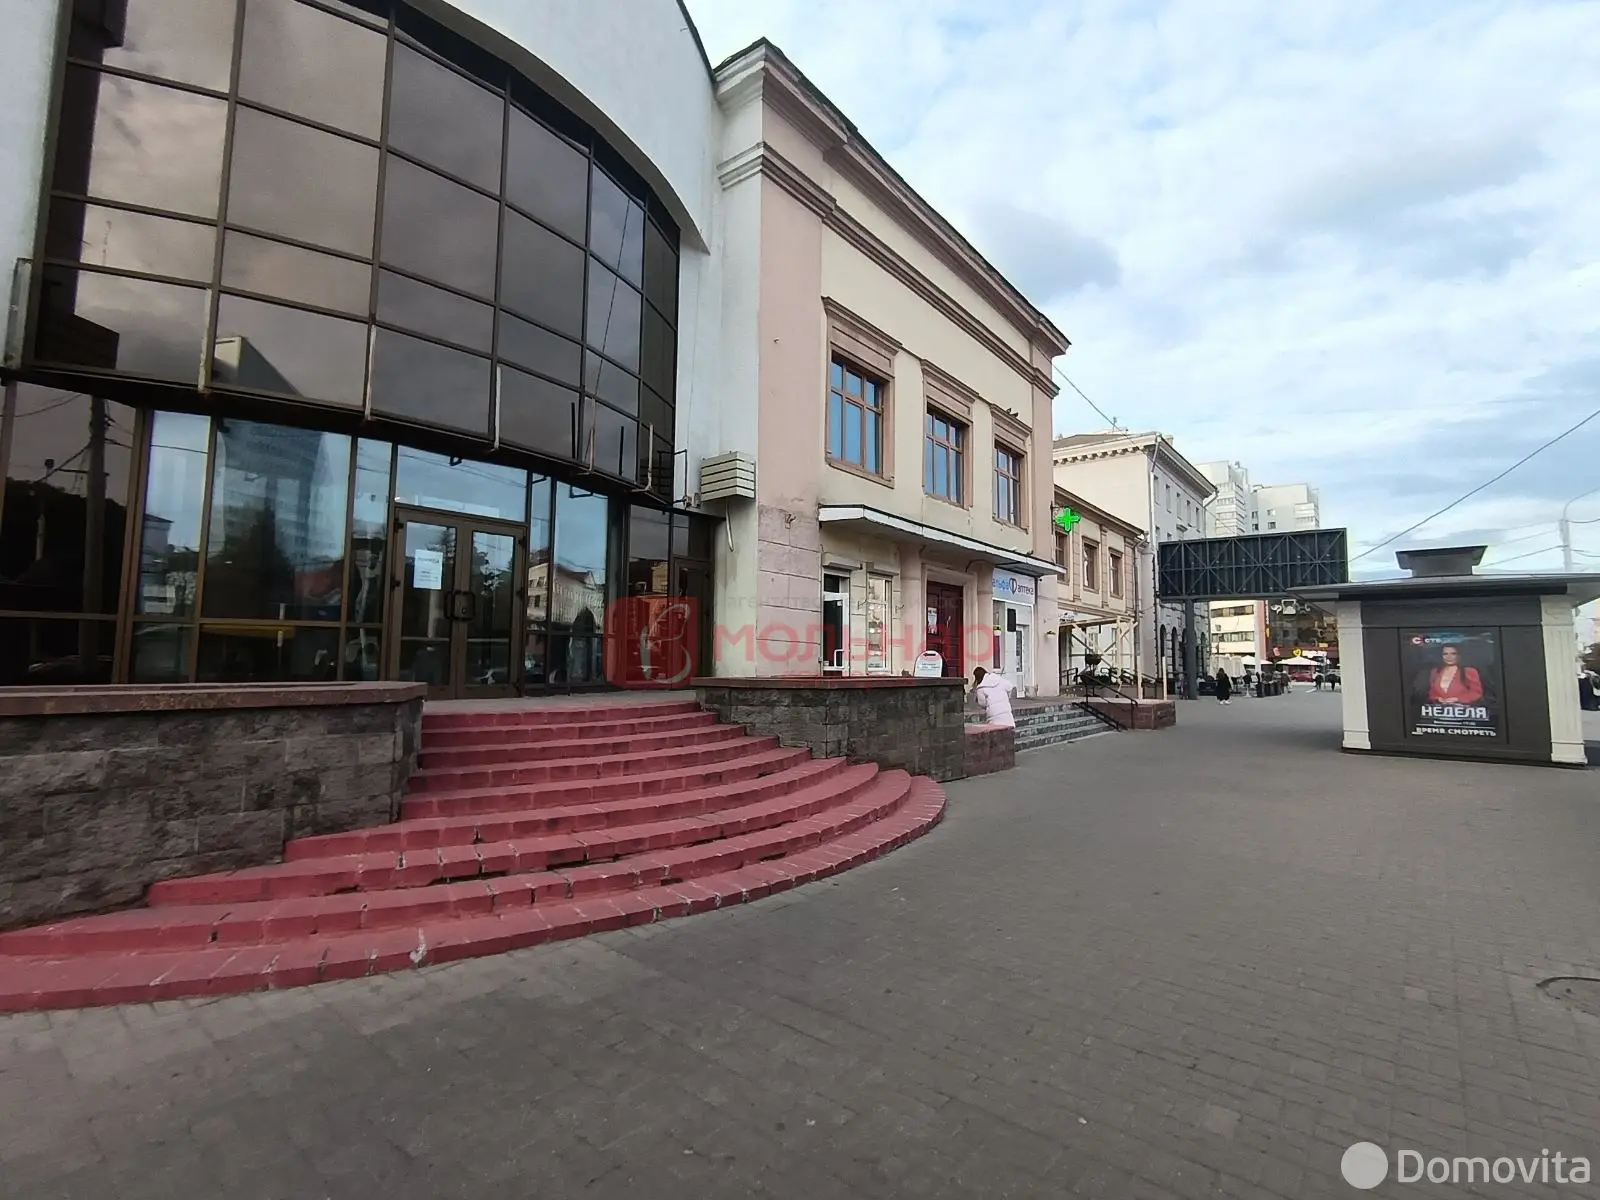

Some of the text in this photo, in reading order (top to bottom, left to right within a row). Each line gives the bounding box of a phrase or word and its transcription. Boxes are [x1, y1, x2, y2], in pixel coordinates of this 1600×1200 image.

[1017, 584, 1034, 596] аптека
[1421, 705, 1487, 719] НЕДЕЛЯ
[1448, 728, 1496, 737] СМОТРЕТЬ
